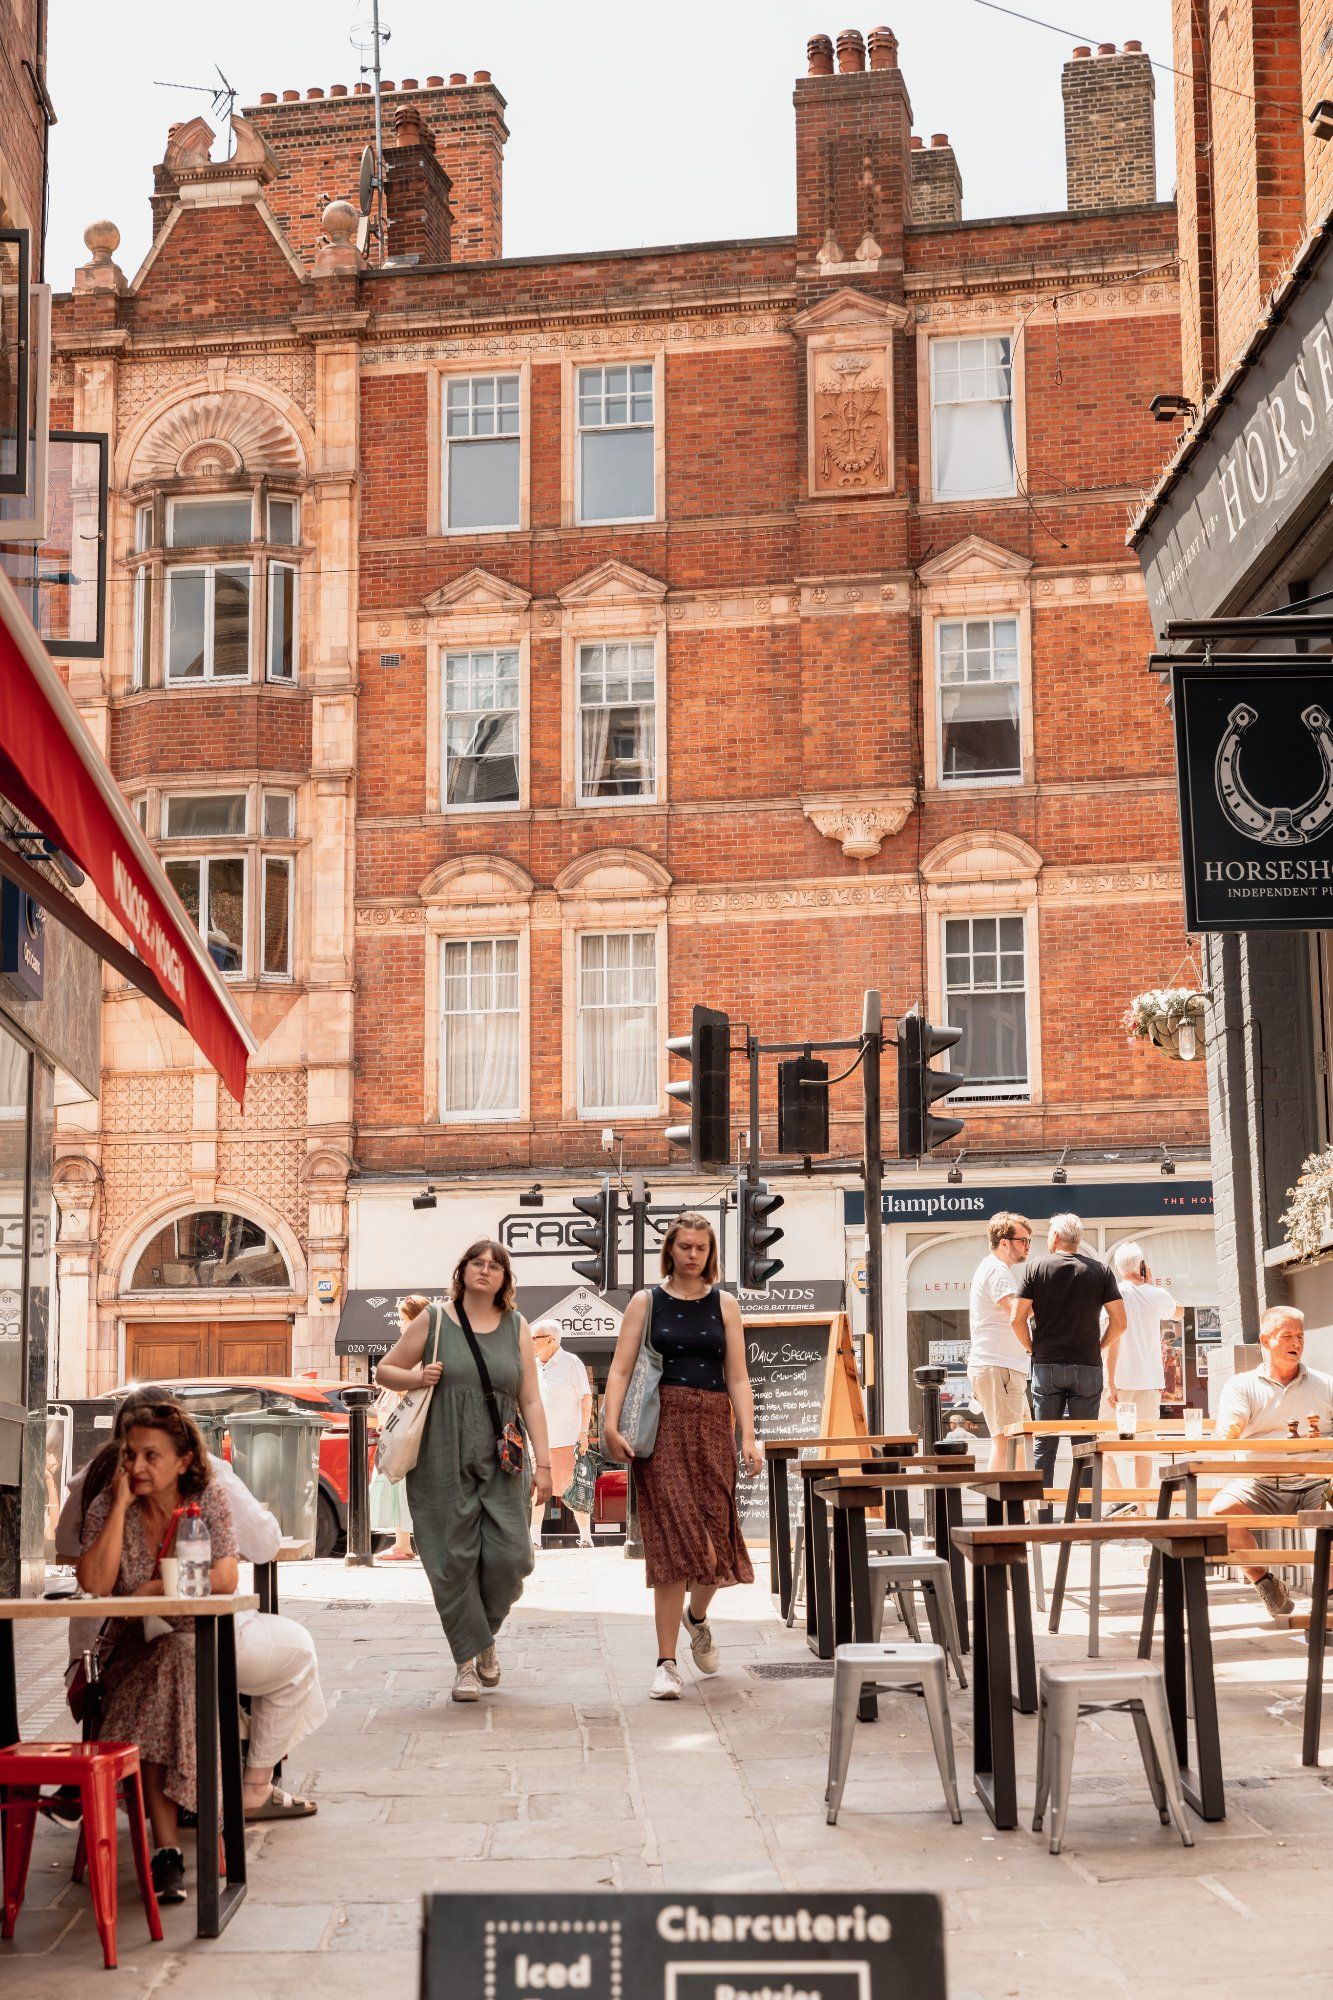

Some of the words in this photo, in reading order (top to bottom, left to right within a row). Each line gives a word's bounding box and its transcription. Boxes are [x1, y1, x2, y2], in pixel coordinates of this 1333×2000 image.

[1204, 860, 1333, 881] HORSESH
[1228, 887, 1318, 898] INDEPENDENT
[880, 1195, 985, 1216] Hamptons
[1163, 1197, 1185, 1205] THE
[925, 1282, 972, 1291] LETTI
[577, 1292, 587, 1300] 19
[554, 1317, 615, 1331] ACETS
[347, 1344, 365, 1353] 020
[367, 1343, 388, 1353] 7794
[748, 1342, 779, 1364] DAILY
[781, 1343, 822, 1362] SPECIALS
[655, 1904, 892, 1943] Charcuterie
[514, 1953, 592, 1989] Iced
